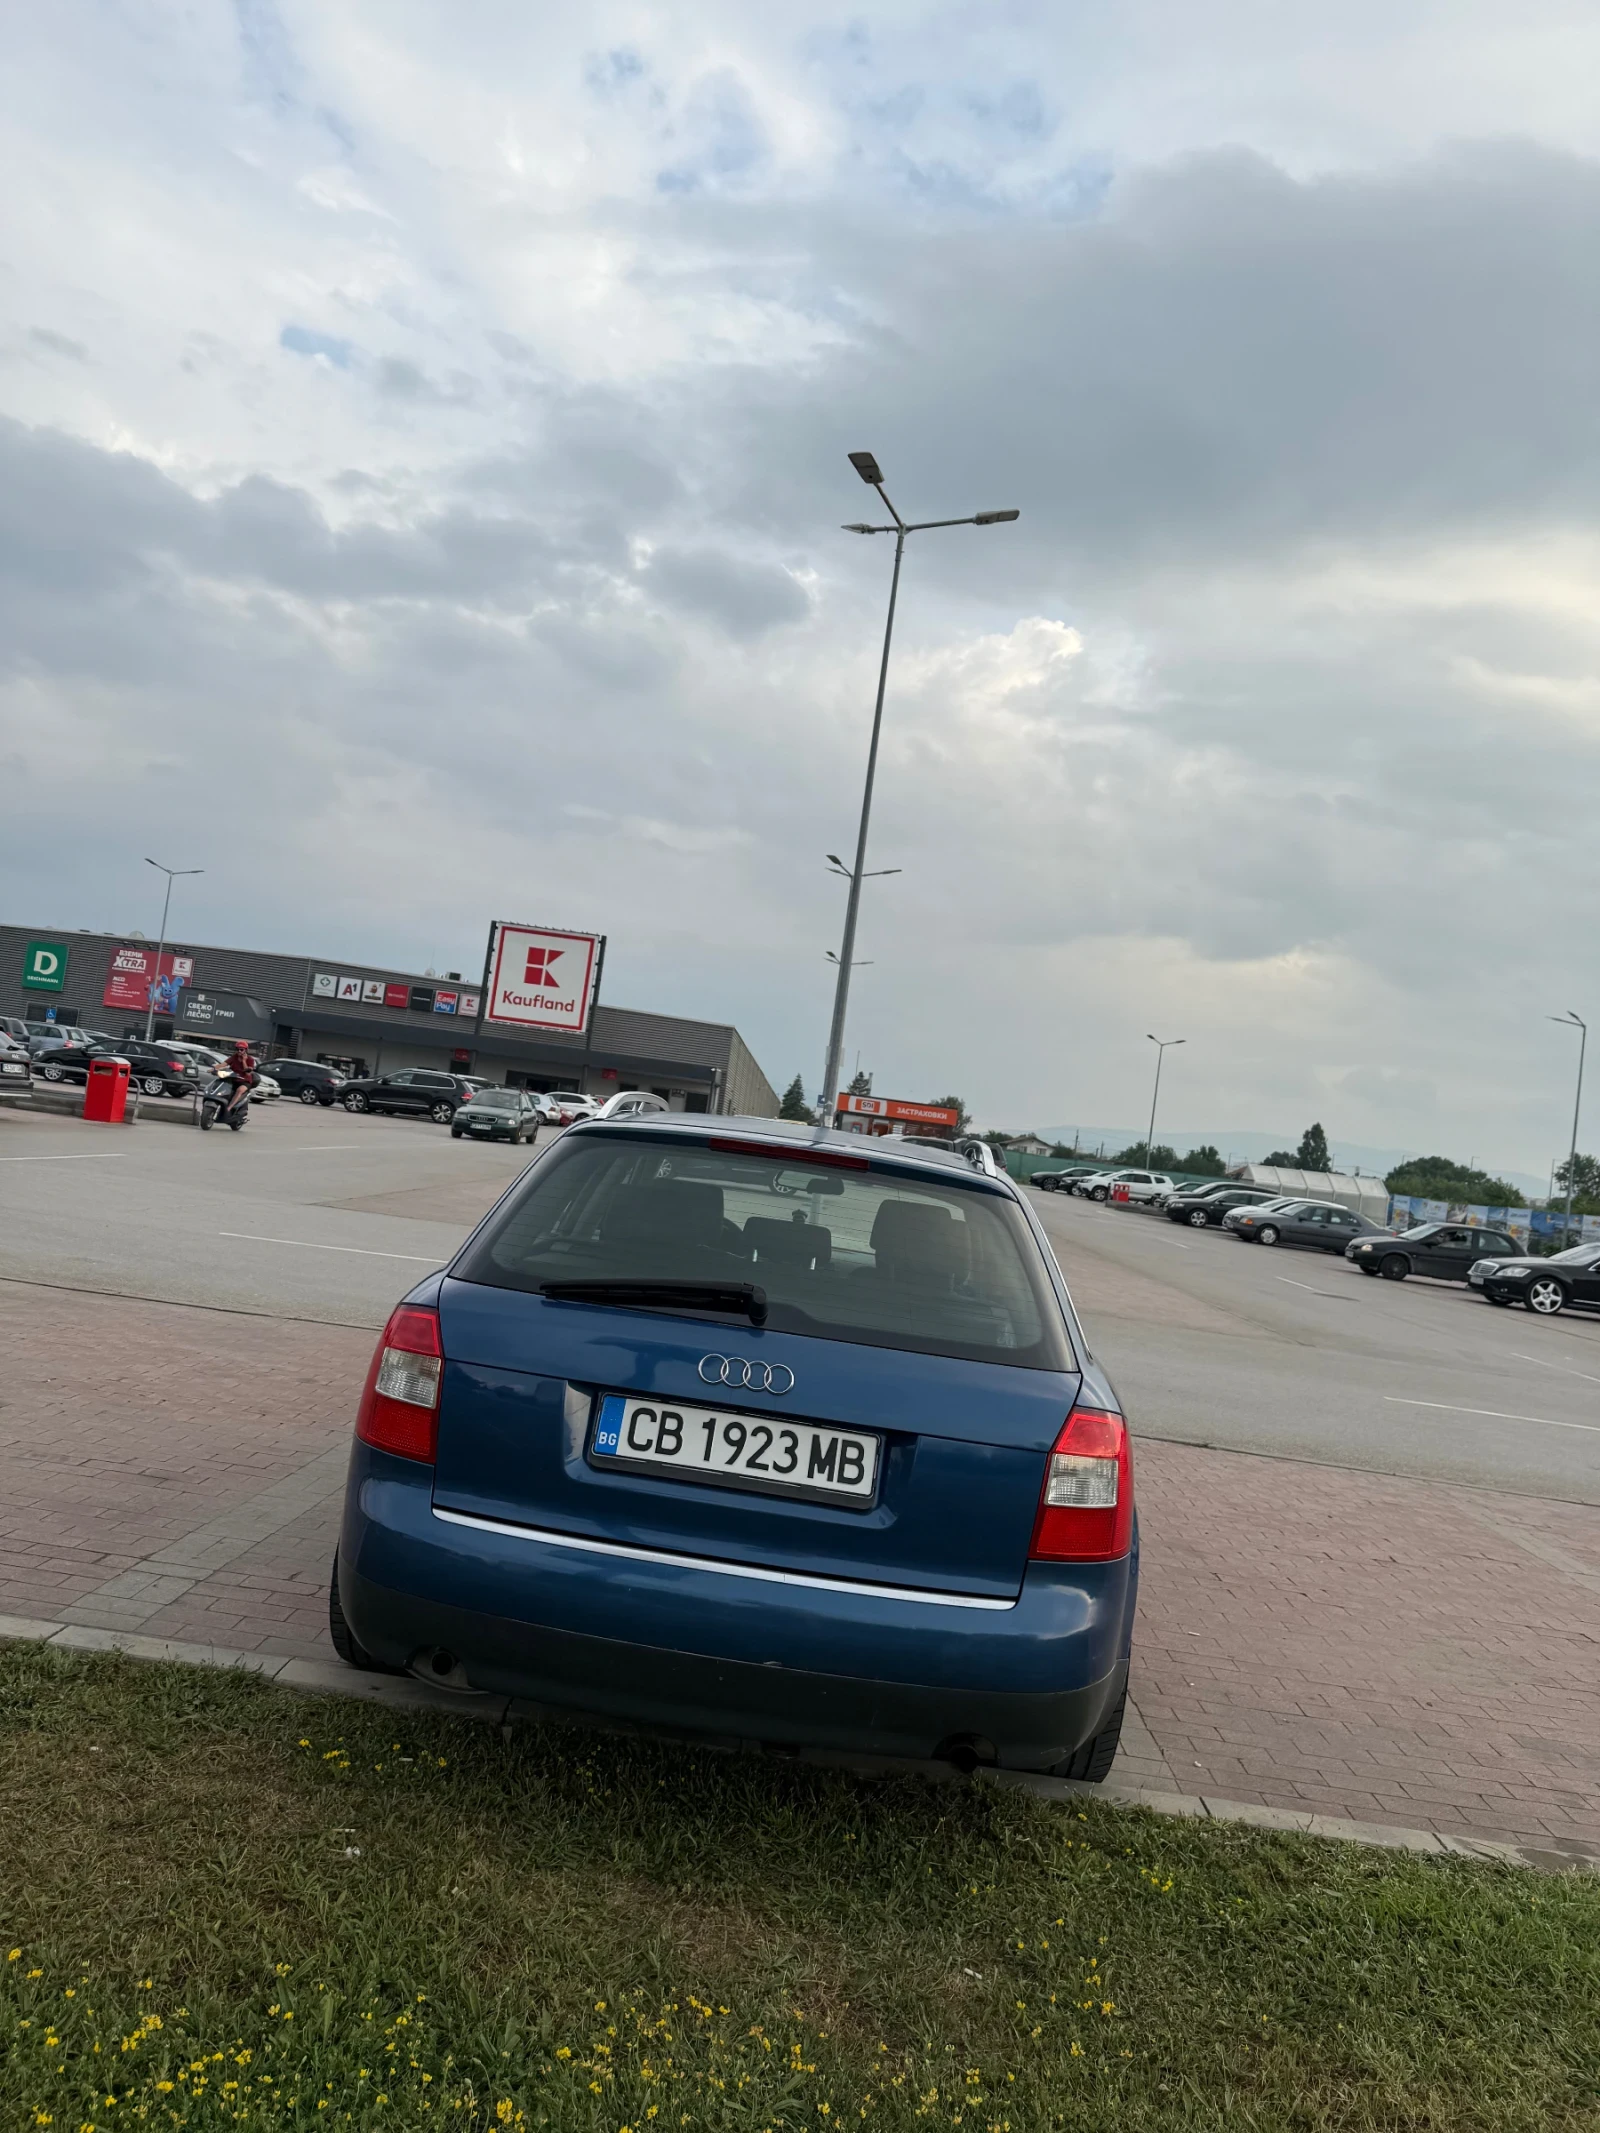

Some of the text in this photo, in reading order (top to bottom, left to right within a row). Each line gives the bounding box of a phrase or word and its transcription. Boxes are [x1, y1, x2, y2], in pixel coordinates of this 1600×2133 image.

[33, 950, 58, 975] D
[112, 956, 147, 970] XTRA
[437, 994, 456, 1003] Easy
[502, 990, 575, 1012] Kaufland
[187, 1002, 213, 1011] СВЕЖО
[436, 1002, 451, 1011] Pay
[186, 1010, 211, 1019] ЛЕСНО
[215, 1009, 235, 1018] ГРИЛ
[862, 1101, 874, 1109] SDI
[896, 1107, 947, 1120] ЗАСТРАХОВКИ
[598, 1431, 618, 1446] BG
[702, 1418, 799, 1473] 1923
